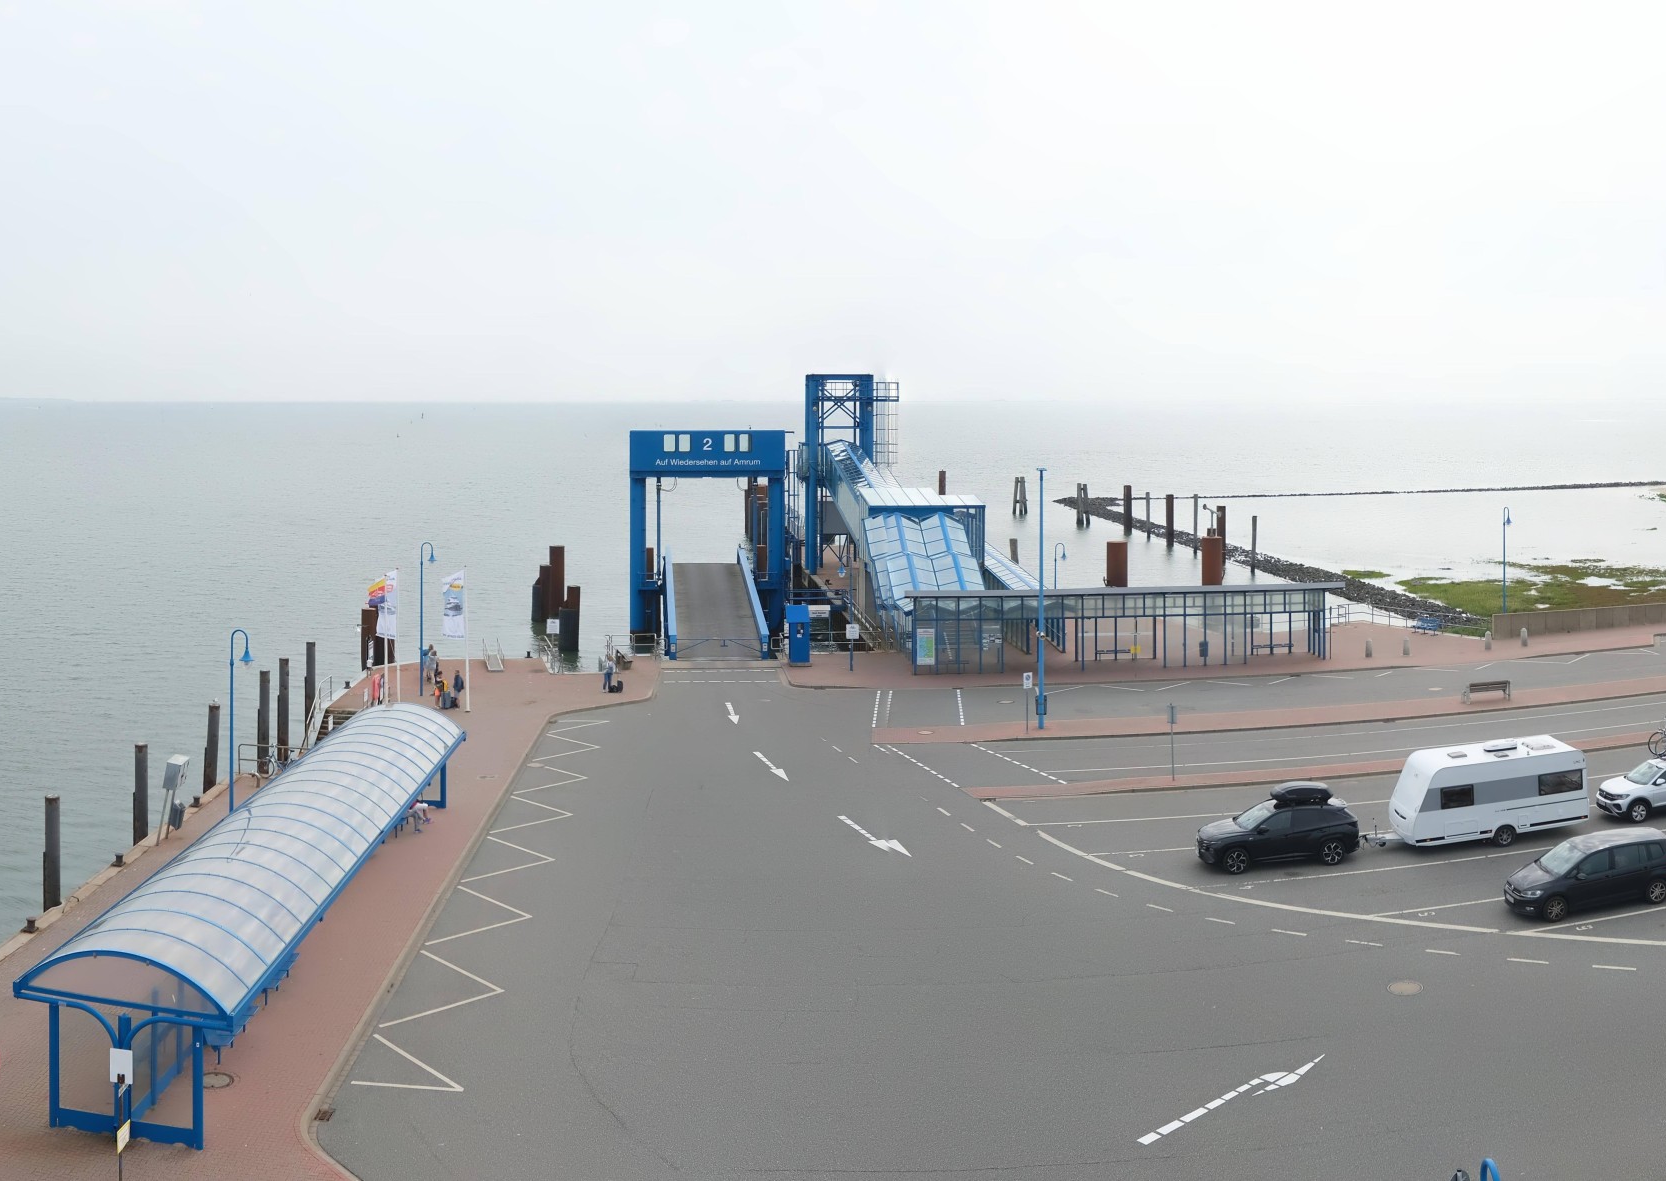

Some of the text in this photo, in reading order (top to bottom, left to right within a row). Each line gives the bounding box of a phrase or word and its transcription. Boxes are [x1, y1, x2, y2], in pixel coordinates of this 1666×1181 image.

[702, 437, 713, 451] 2
[655, 458, 761, 466] Auf Wiedersehen auf Amrum
